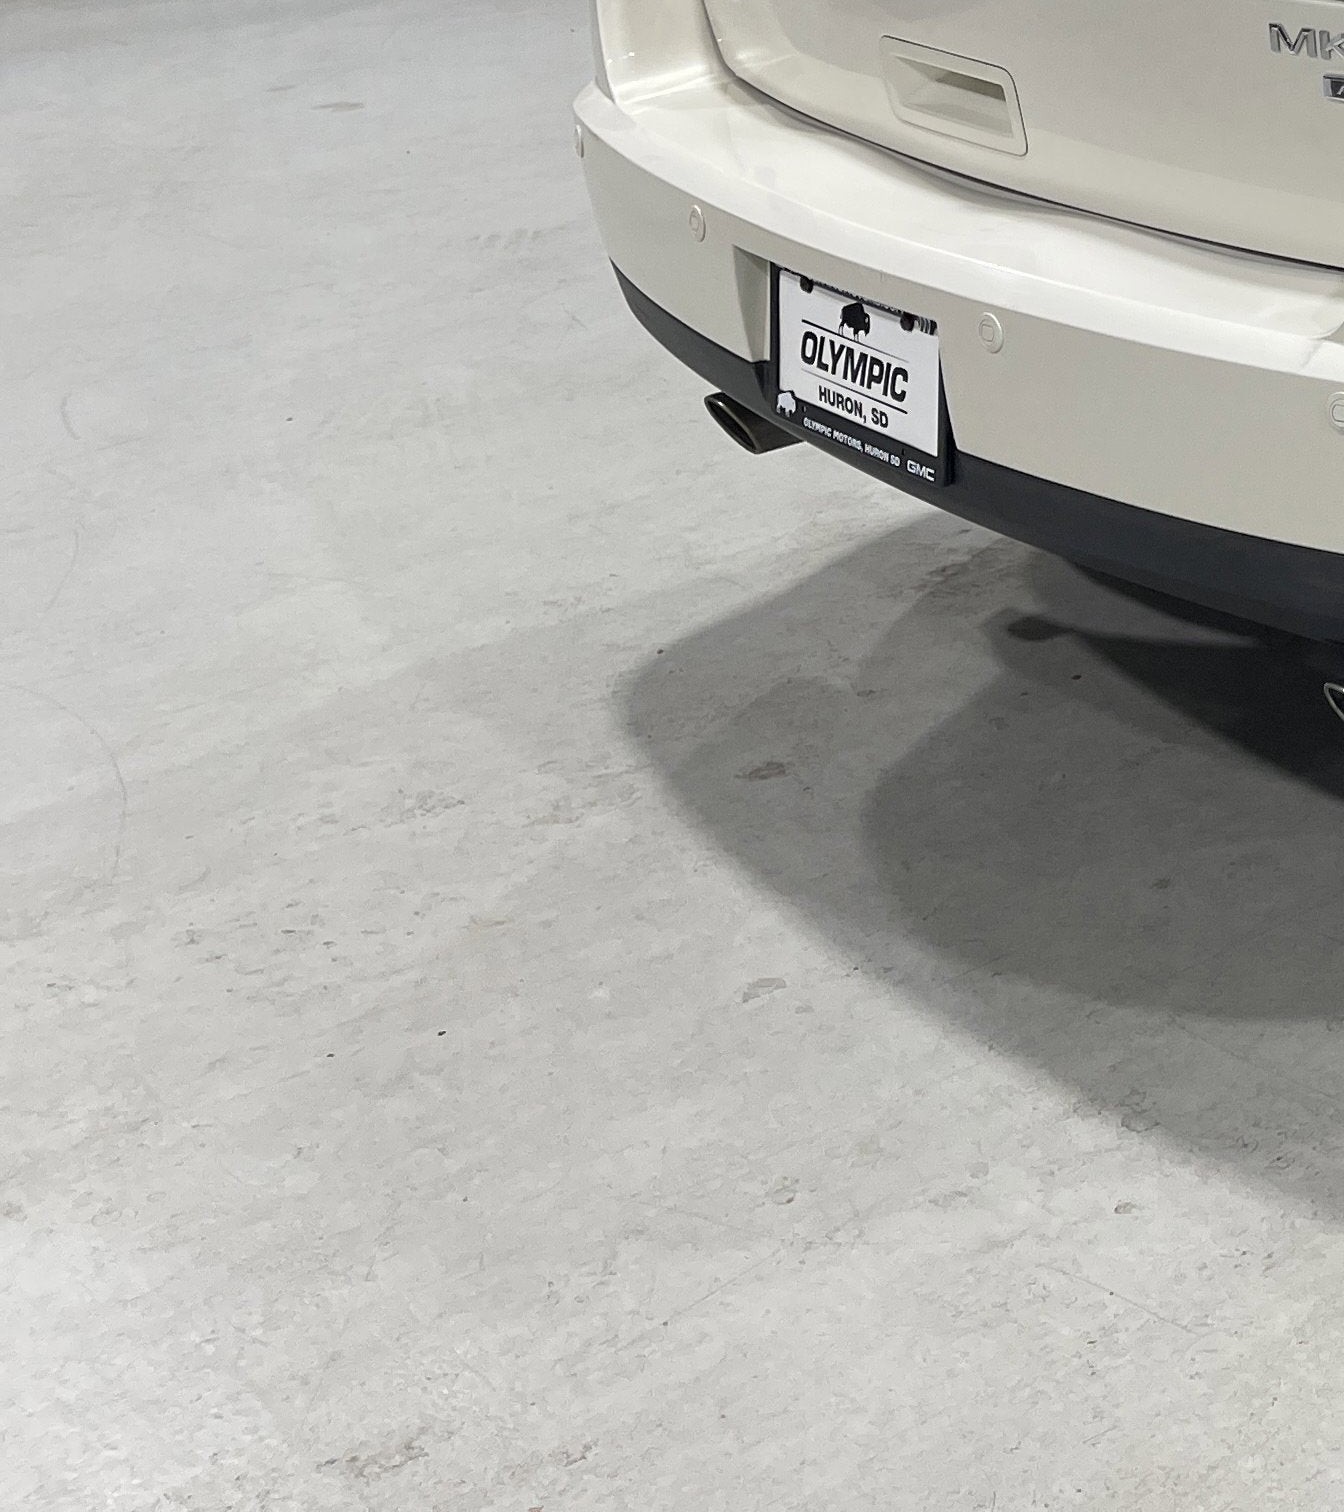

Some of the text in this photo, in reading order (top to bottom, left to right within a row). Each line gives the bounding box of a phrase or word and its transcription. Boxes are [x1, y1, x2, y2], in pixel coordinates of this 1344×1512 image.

[801, 330, 909, 402] OLYMPIC
[818, 385, 889, 429] HURON, SD
[803, 417, 832, 438] OLYMPIC
[864, 444, 889, 463] HURON
[890, 454, 900, 467] SD
[906, 459, 935, 482] GMC
